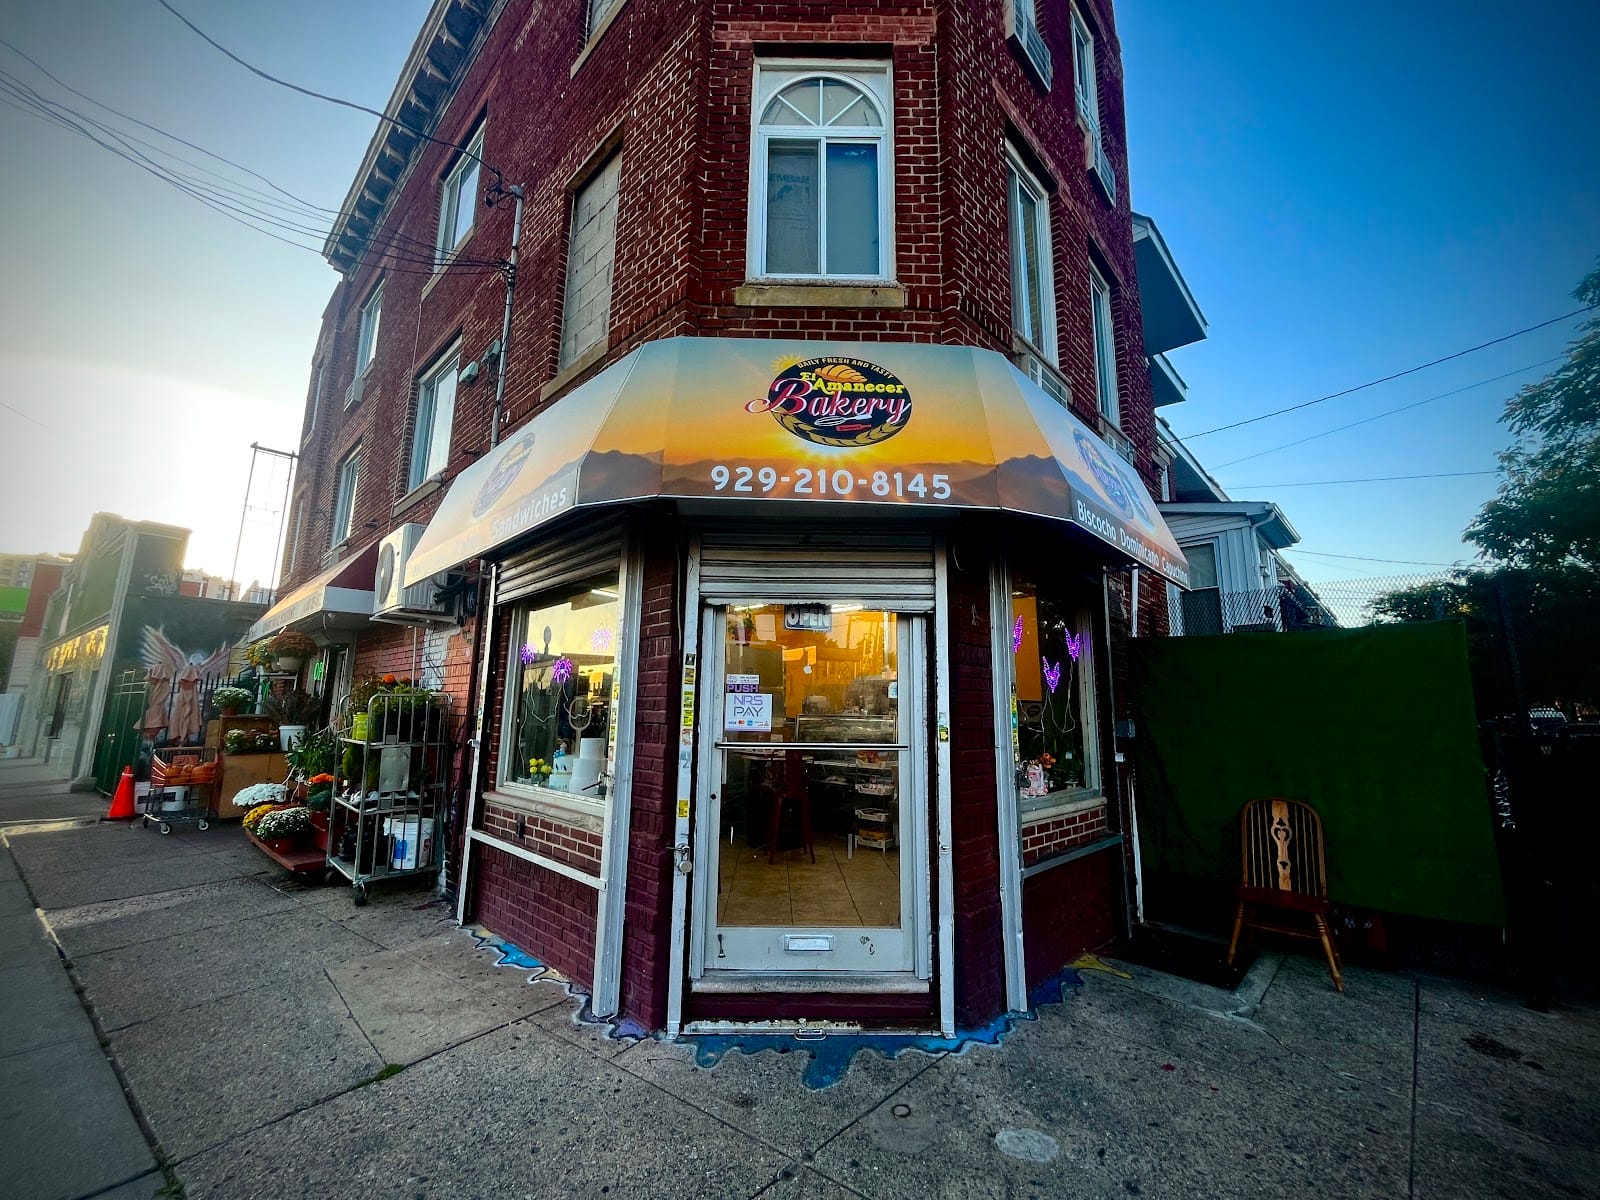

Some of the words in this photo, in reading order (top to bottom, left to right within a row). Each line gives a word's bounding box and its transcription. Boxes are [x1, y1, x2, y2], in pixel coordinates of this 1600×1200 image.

[797, 358, 821, 369] DAILY
[851, 359, 869, 368] AND
[870, 364, 895, 379] TASTY
[799, 371, 816, 381] El
[811, 378, 905, 395] Amanecer
[744, 377, 912, 424] Bakery
[710, 465, 952, 500] 929-210-8145
[492, 487, 568, 538] Sandwiches
[1077, 499, 1117, 541] Biscocho
[1119, 527, 1160, 567] Dominicano
[726, 684, 759, 693] PUSH
[733, 694, 763, 706] NRS
[733, 706, 764, 718] PAY
